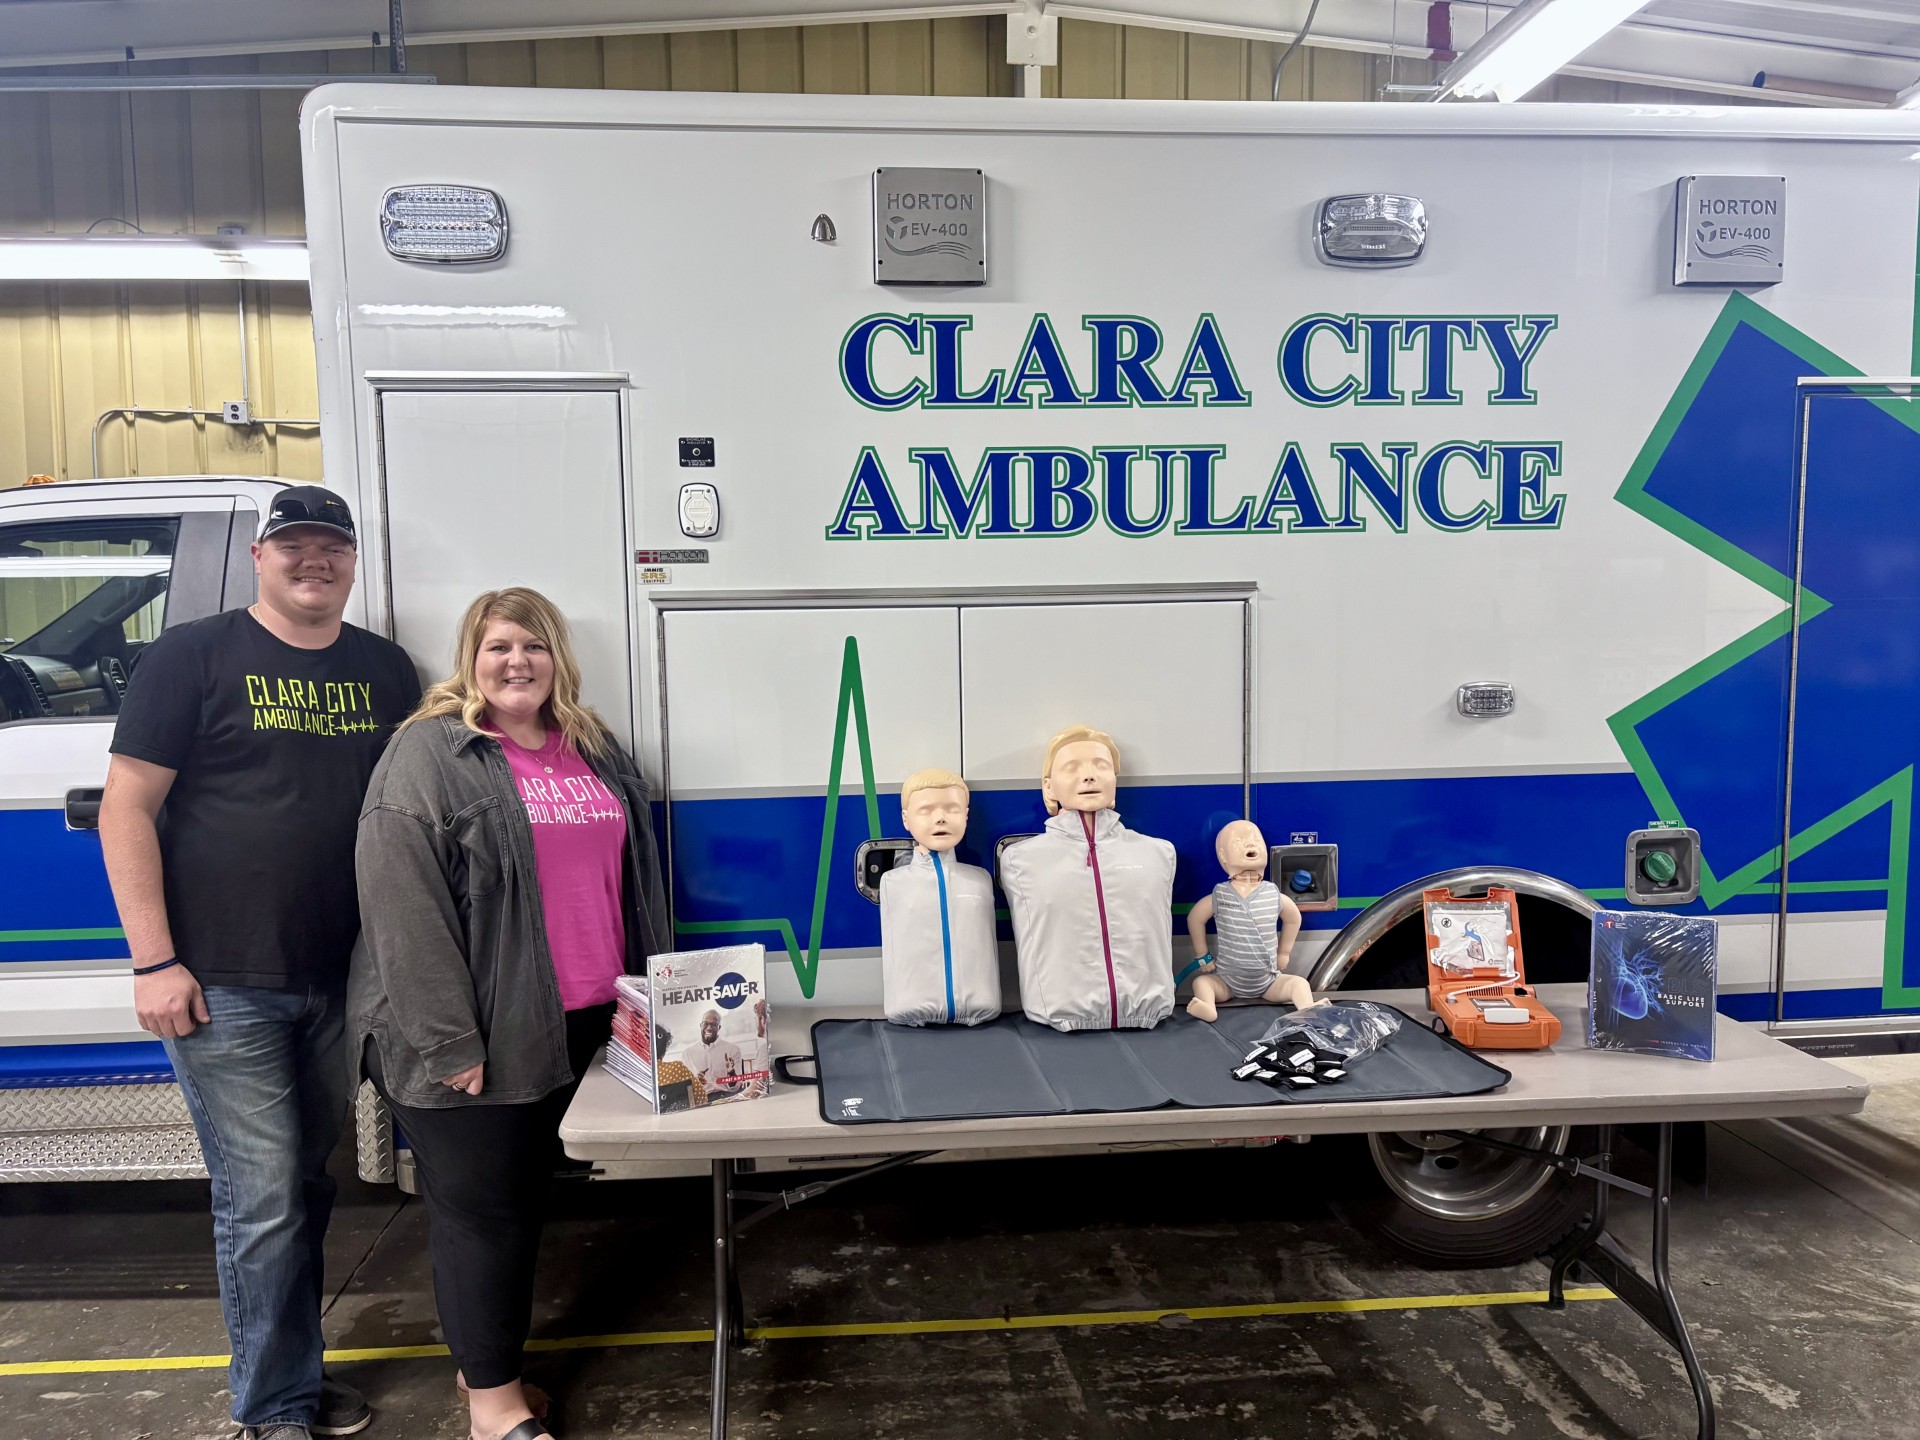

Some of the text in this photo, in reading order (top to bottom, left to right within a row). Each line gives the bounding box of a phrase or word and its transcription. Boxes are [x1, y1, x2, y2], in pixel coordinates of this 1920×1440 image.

[887, 193, 973, 210] HORTON
[1699, 199, 1777, 215] HORTON
[911, 222, 968, 236] EV-400
[1719, 227, 1771, 240] EV-400
[839, 312, 1559, 412] CLARA CITY
[825, 440, 1567, 540] AMBULANCE
[659, 550, 705, 559] Horton
[245, 675, 371, 713] CLARA CITY
[253, 708, 337, 736] AMBULANCE
[521, 775, 613, 803] ARA CITY
[525, 803, 588, 824] BULANCE
[662, 981, 758, 1006] HEARTSAVER
[1666, 999, 1705, 1008] SUPPORT
